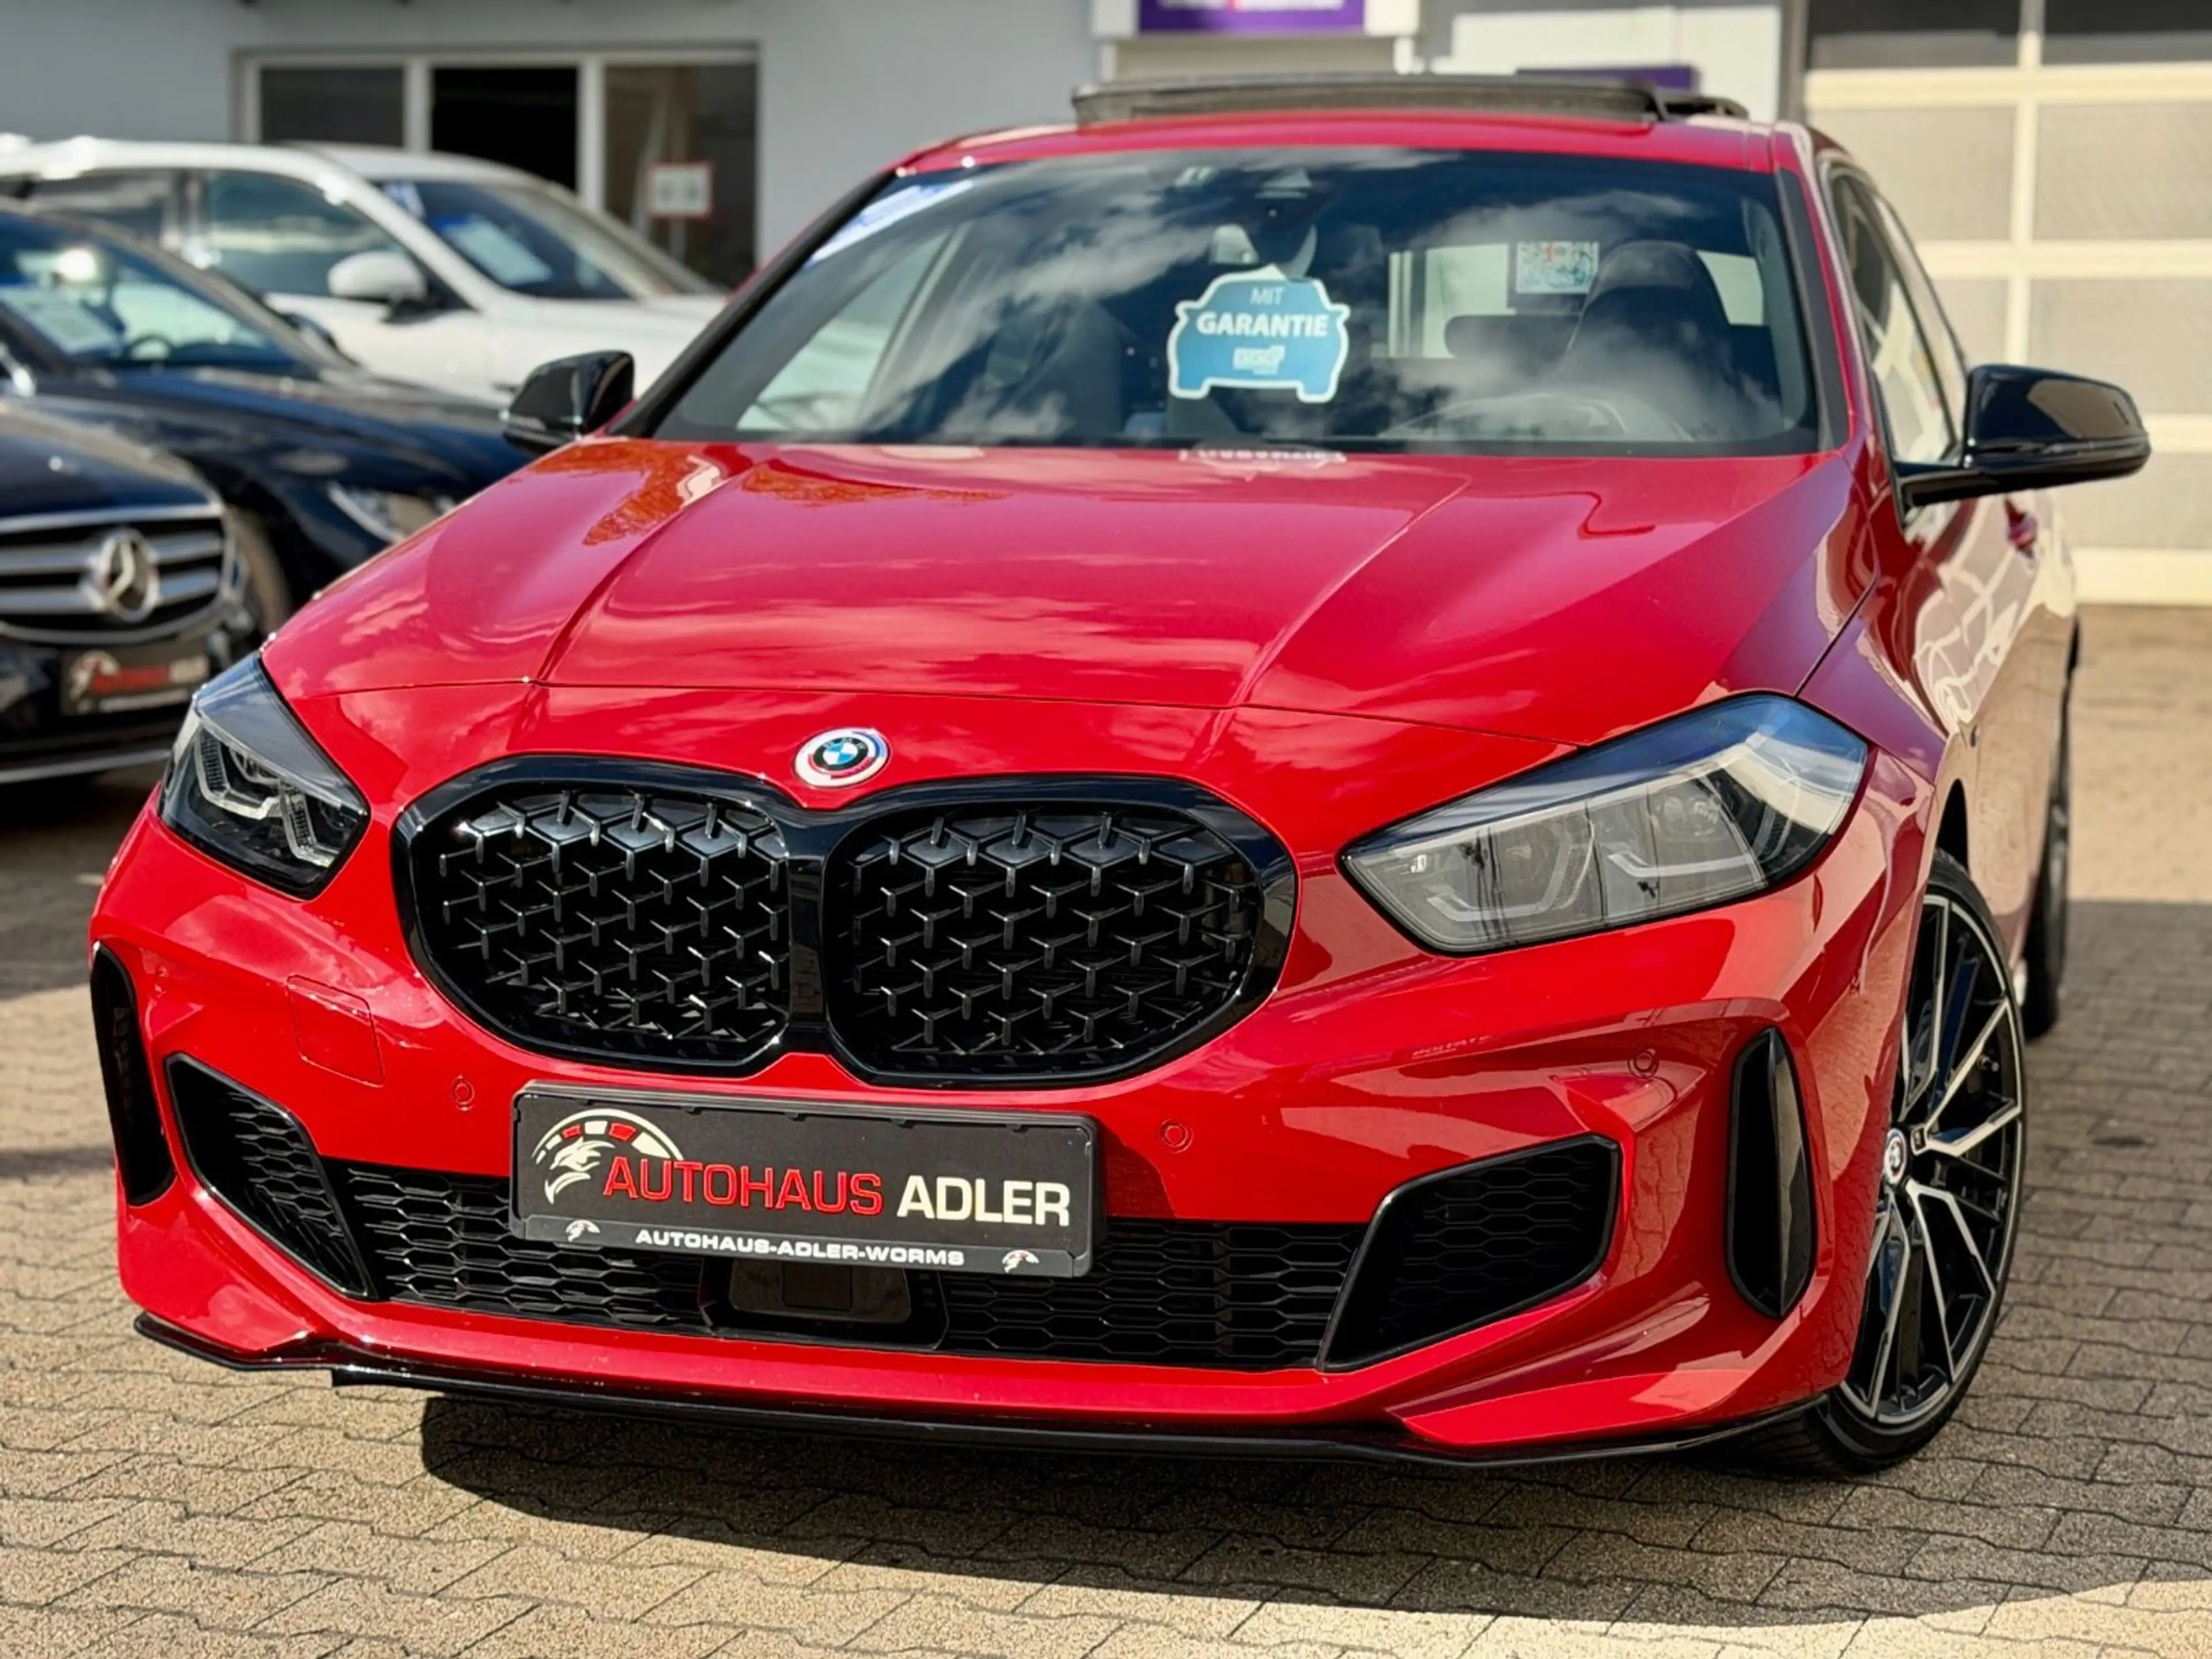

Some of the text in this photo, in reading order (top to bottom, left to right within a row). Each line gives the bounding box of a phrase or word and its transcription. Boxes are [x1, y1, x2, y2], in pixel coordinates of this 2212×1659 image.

[1249, 287, 1284, 306] MIT
[1196, 312, 1330, 337] GARANTIE
[603, 1156, 1070, 1227] AUTOHAUS ADLER
[635, 1229, 964, 1266] AUTOHAUS-ADLER-WORMS
